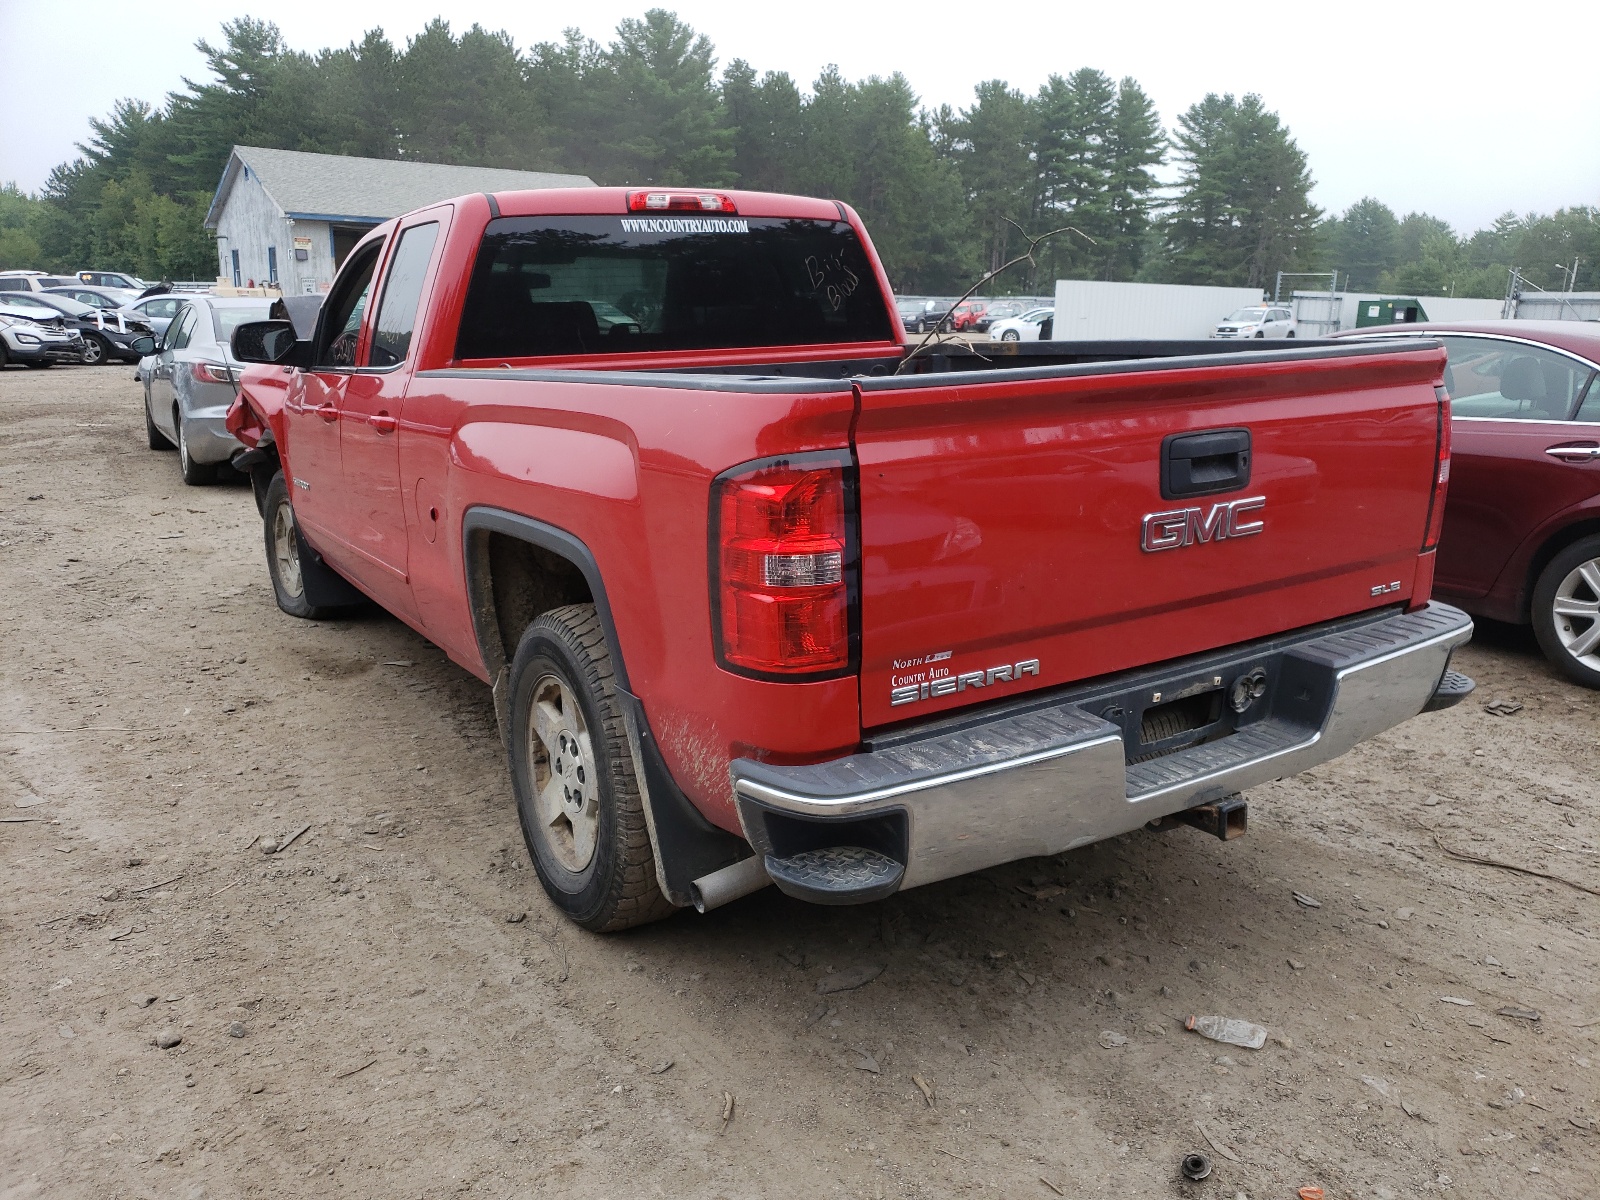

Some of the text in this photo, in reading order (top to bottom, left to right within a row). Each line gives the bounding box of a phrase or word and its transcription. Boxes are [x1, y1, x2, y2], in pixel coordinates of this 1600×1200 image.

[621, 219, 749, 233] WWW.NCOUNTRYAUTO.COM
[1141, 495, 1266, 552] GMC
[1370, 580, 1401, 596] SLE
[891, 658, 1040, 707] SIERRA
